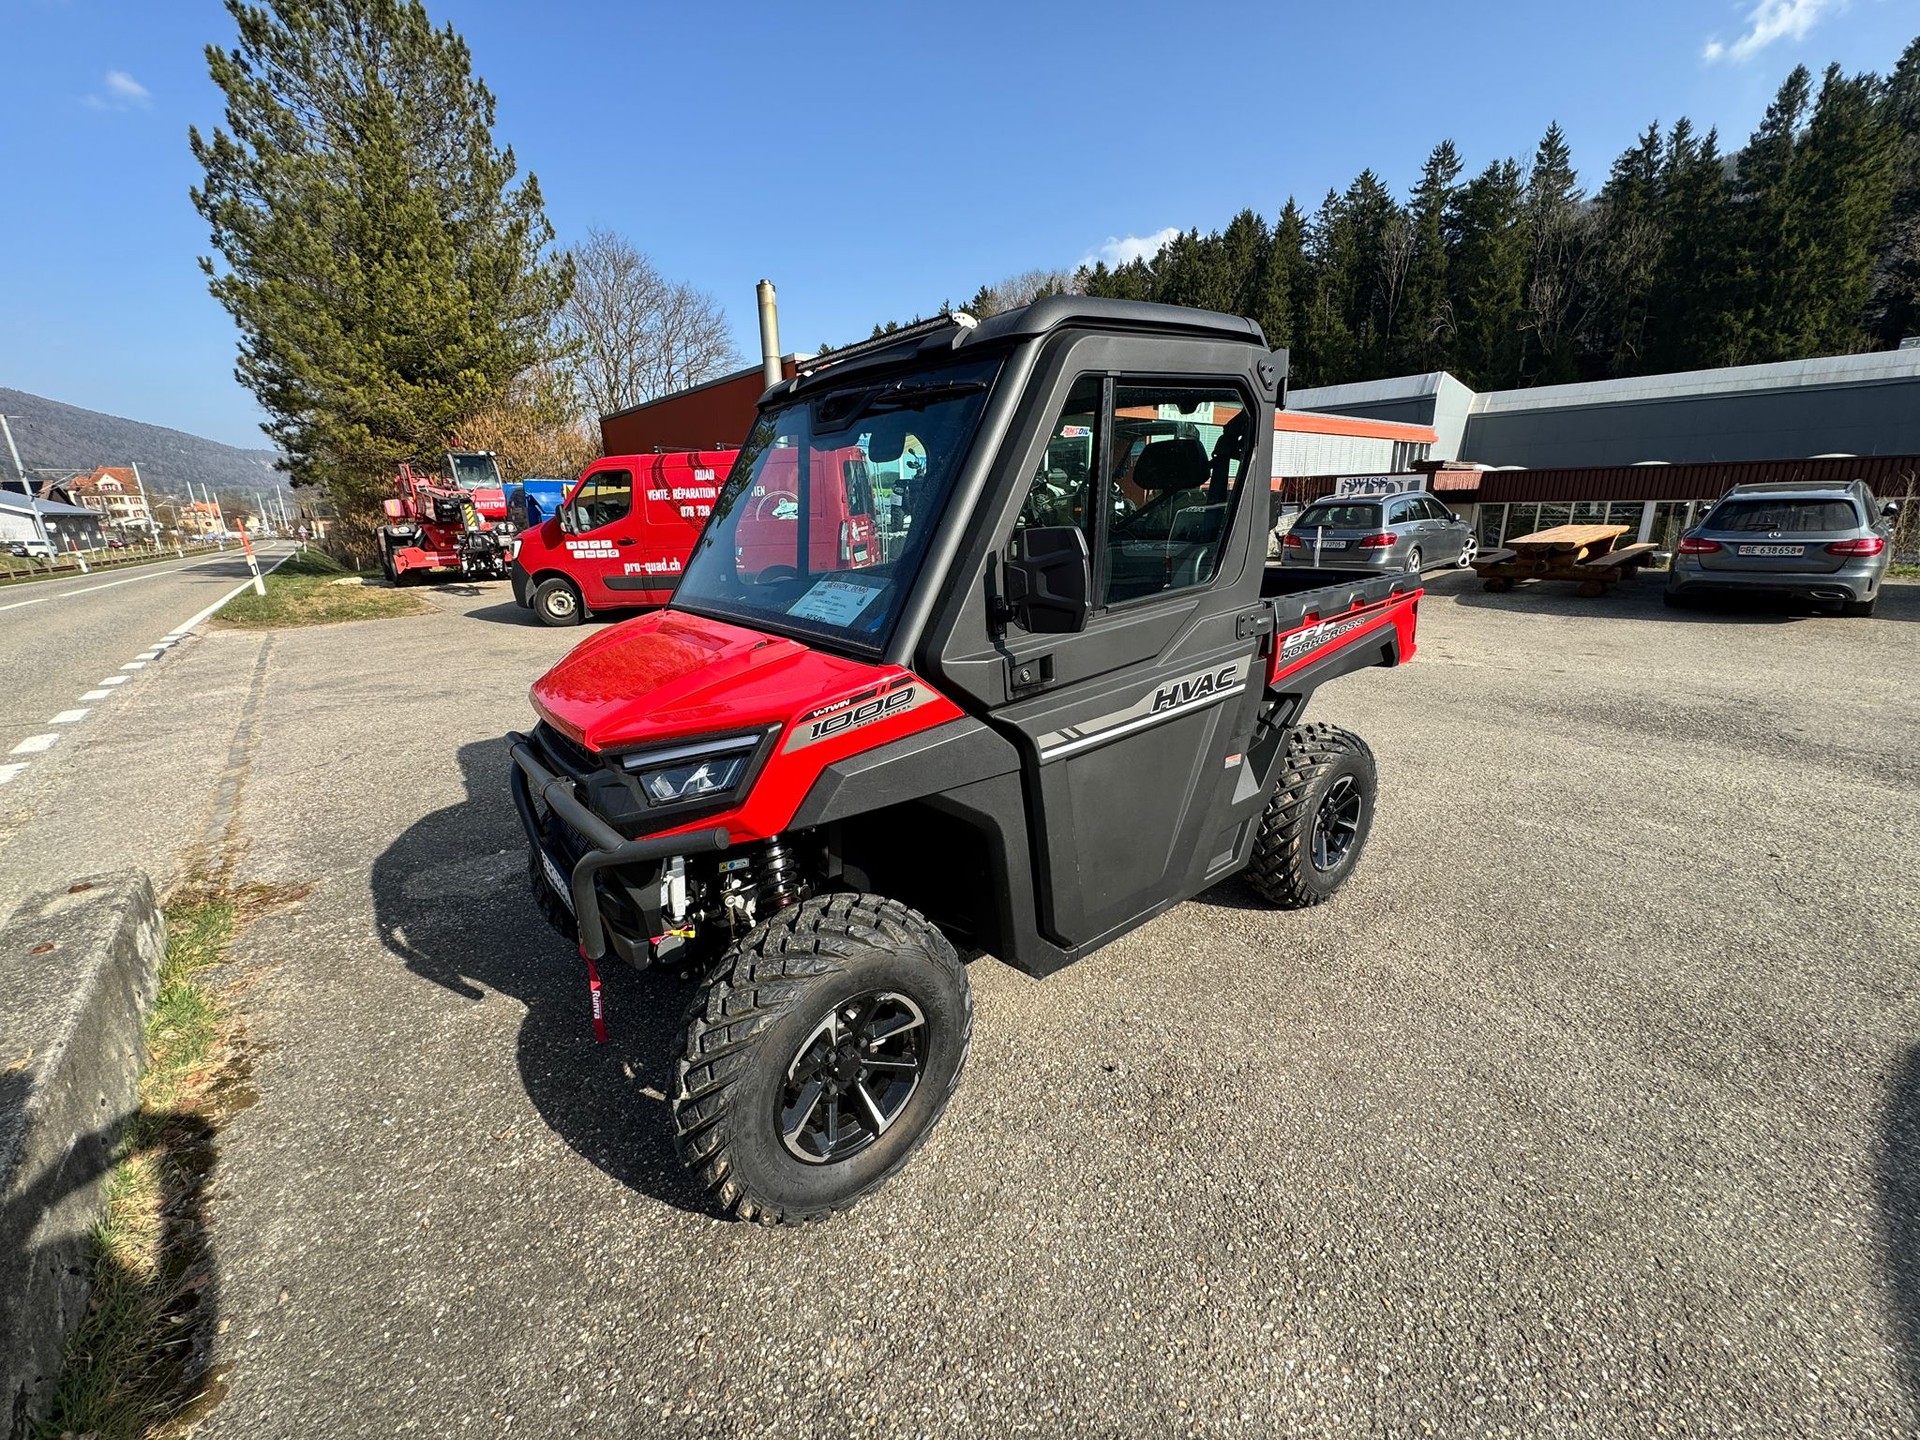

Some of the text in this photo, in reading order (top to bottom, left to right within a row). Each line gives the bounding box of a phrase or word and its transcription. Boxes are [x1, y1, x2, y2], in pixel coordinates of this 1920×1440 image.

[694, 469, 715, 480] QUAD
[1344, 477, 1388, 488] SWISS
[672, 486, 716, 500] RÉPARATION
[680, 505, 711, 517] 078 738
[623, 557, 681, 576] pro-quad.ch
[1150, 664, 1238, 714] HVAC
[810, 685, 916, 741] 1000
[813, 699, 850, 717] V-TWIN
[591, 990, 601, 1019] Runva
